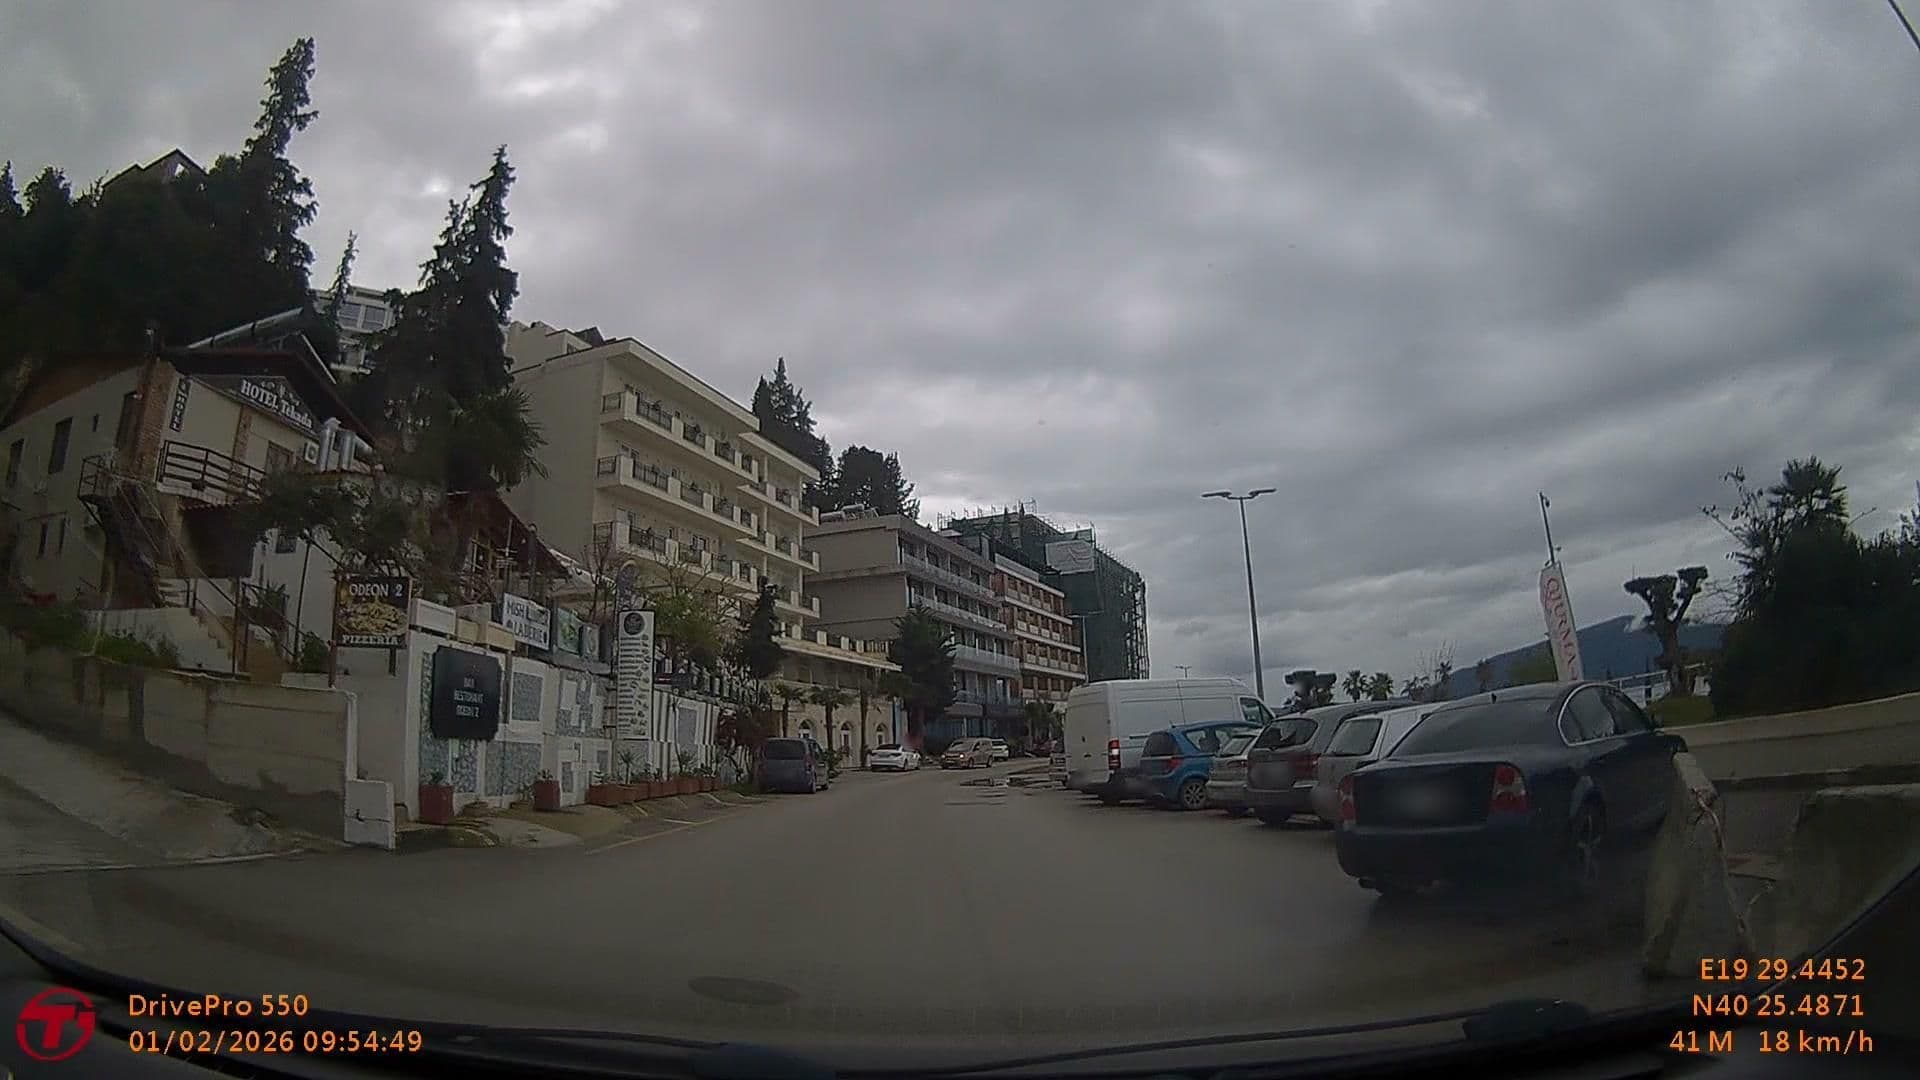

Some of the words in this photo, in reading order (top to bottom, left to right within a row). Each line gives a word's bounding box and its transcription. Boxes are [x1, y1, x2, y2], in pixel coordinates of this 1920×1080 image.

[241, 379, 279, 410] HOTEL
[350, 583, 389, 597] ODEON
[395, 583, 404, 597] 2
[342, 634, 400, 645] PIZZERIA
